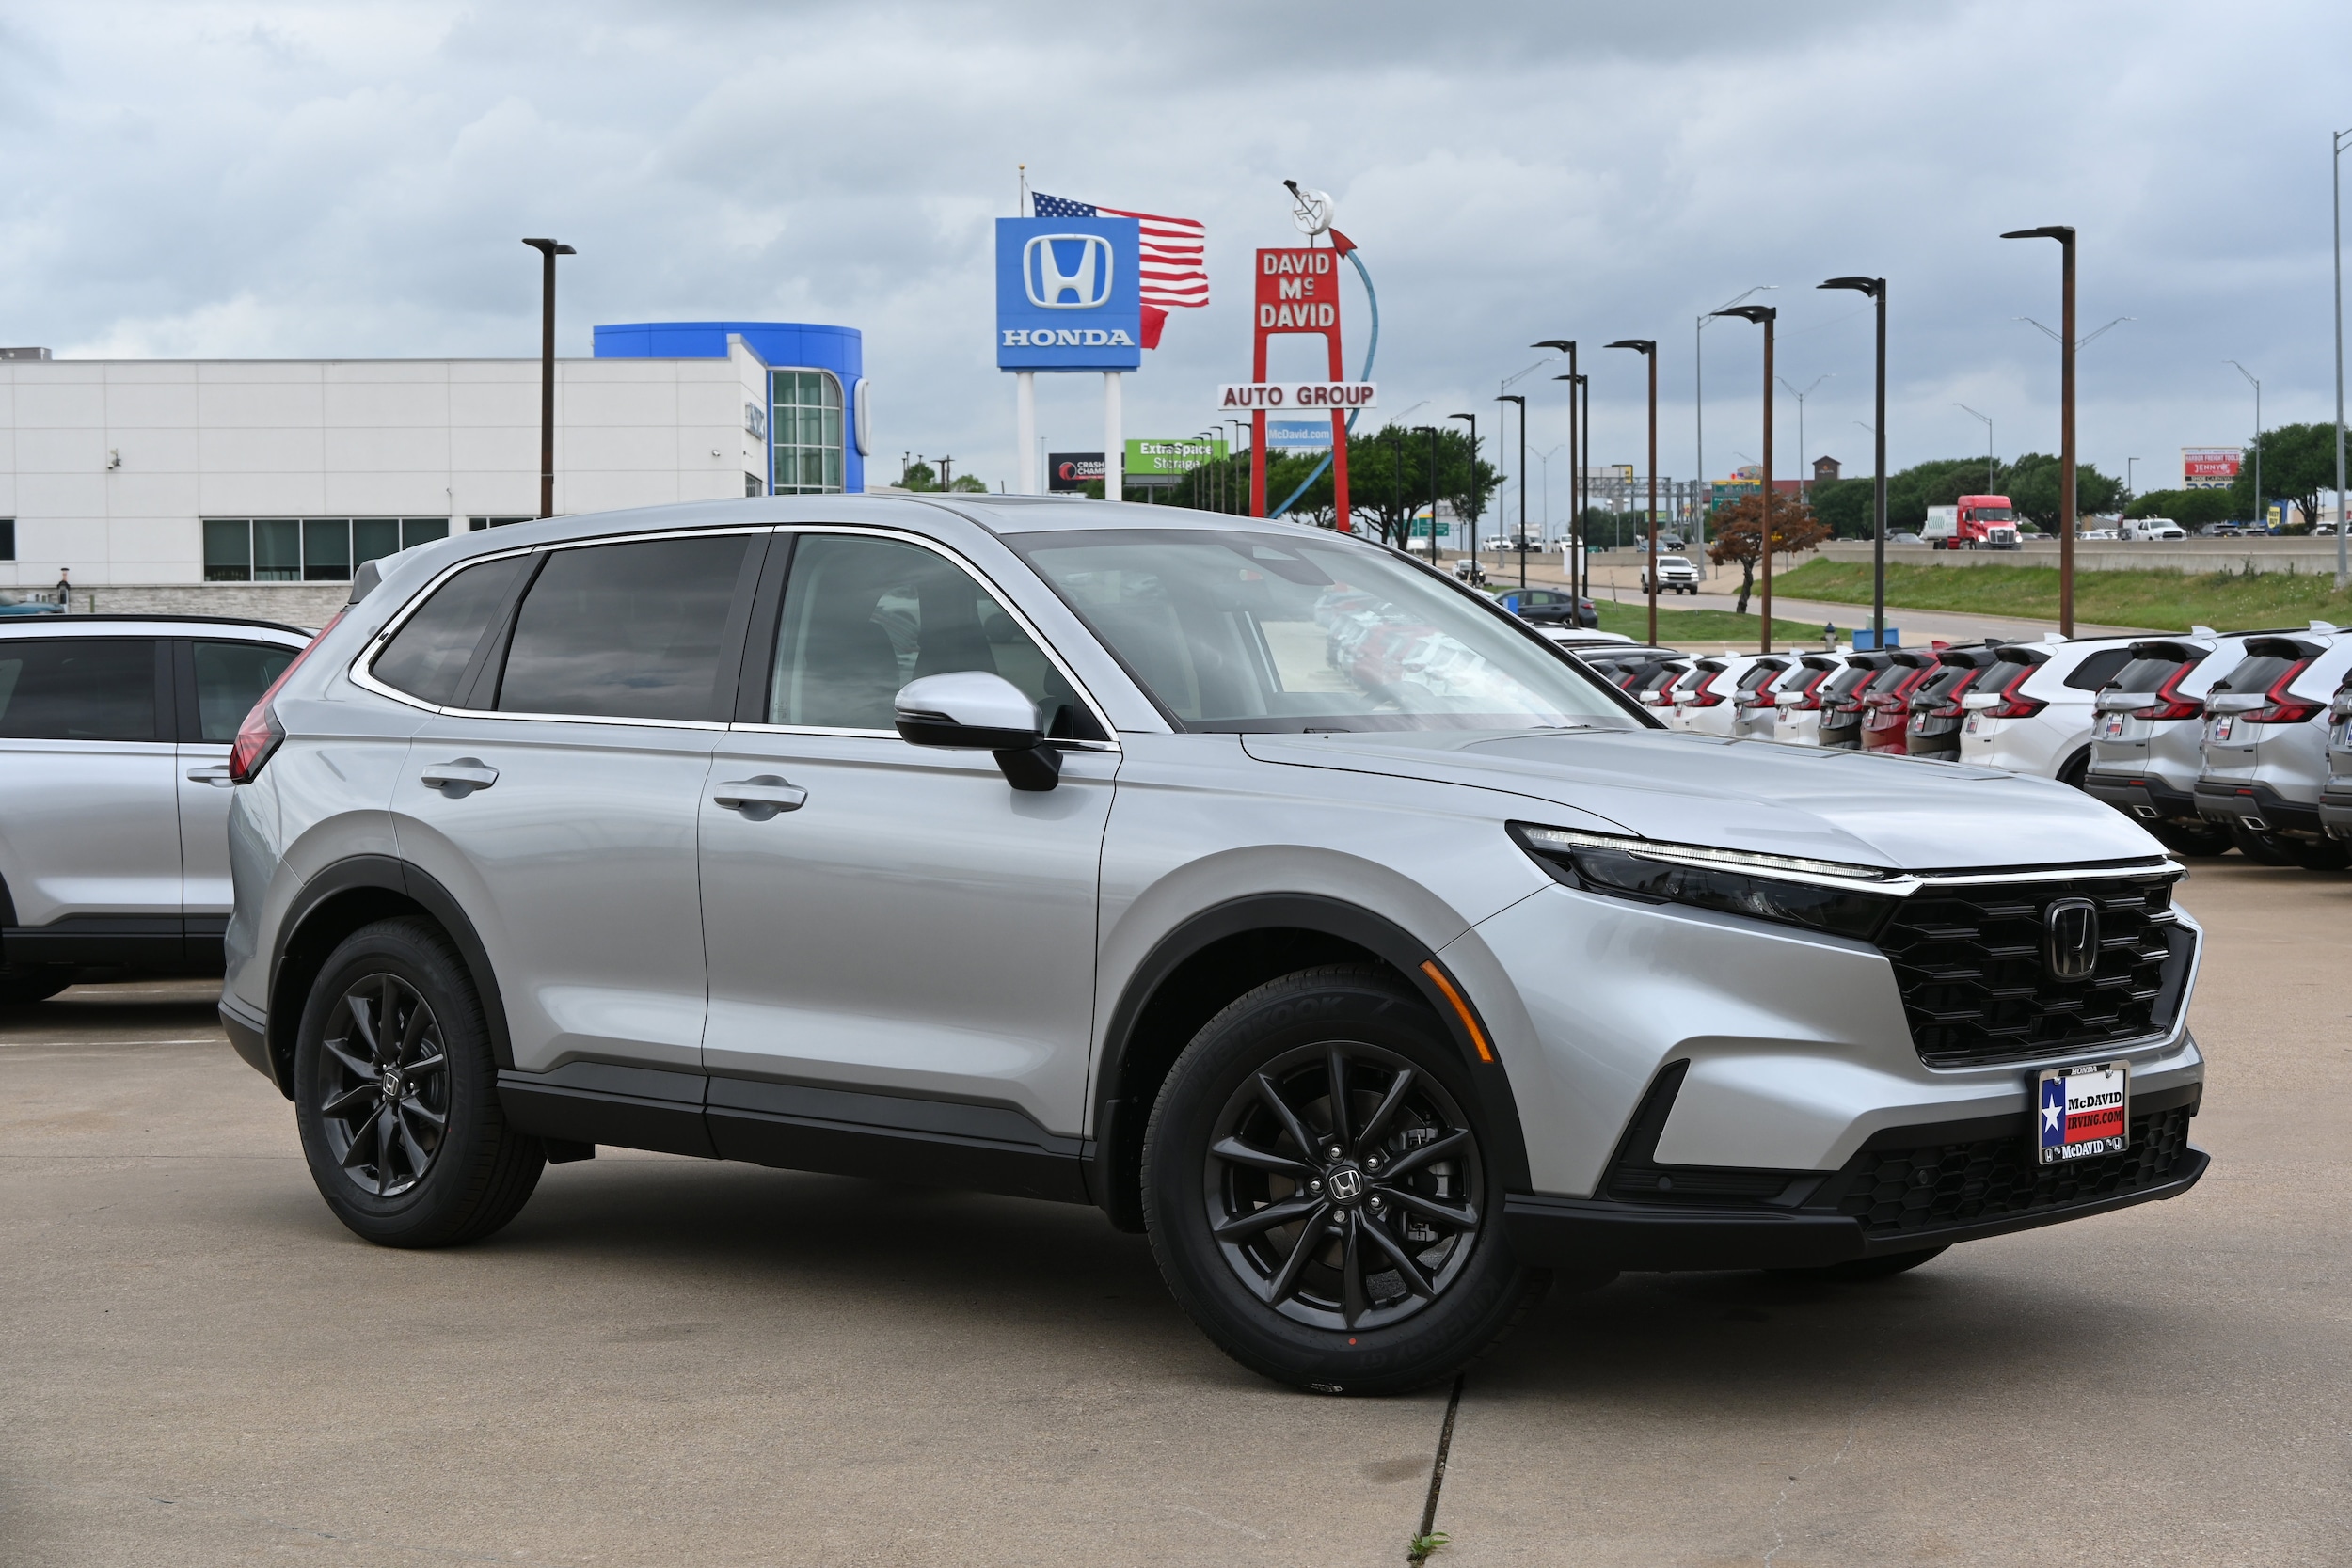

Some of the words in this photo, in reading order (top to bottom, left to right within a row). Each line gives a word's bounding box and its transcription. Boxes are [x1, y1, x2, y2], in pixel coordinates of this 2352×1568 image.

[1263, 252, 1330, 275] DAVID
[1260, 303, 1335, 328] DAVID
[1002, 329, 1135, 347] HONDA
[1223, 387, 1284, 406] AUTO
[1296, 386, 1374, 405] GROUP
[1268, 429, 1330, 439] McDavid.com
[2071, 1065, 2098, 1076] HONDA
[2068, 1091, 2122, 1111] McDAVID
[2067, 1110, 2122, 1130] IRVING.COM
[2061, 1140, 2104, 1159] McDAVID
